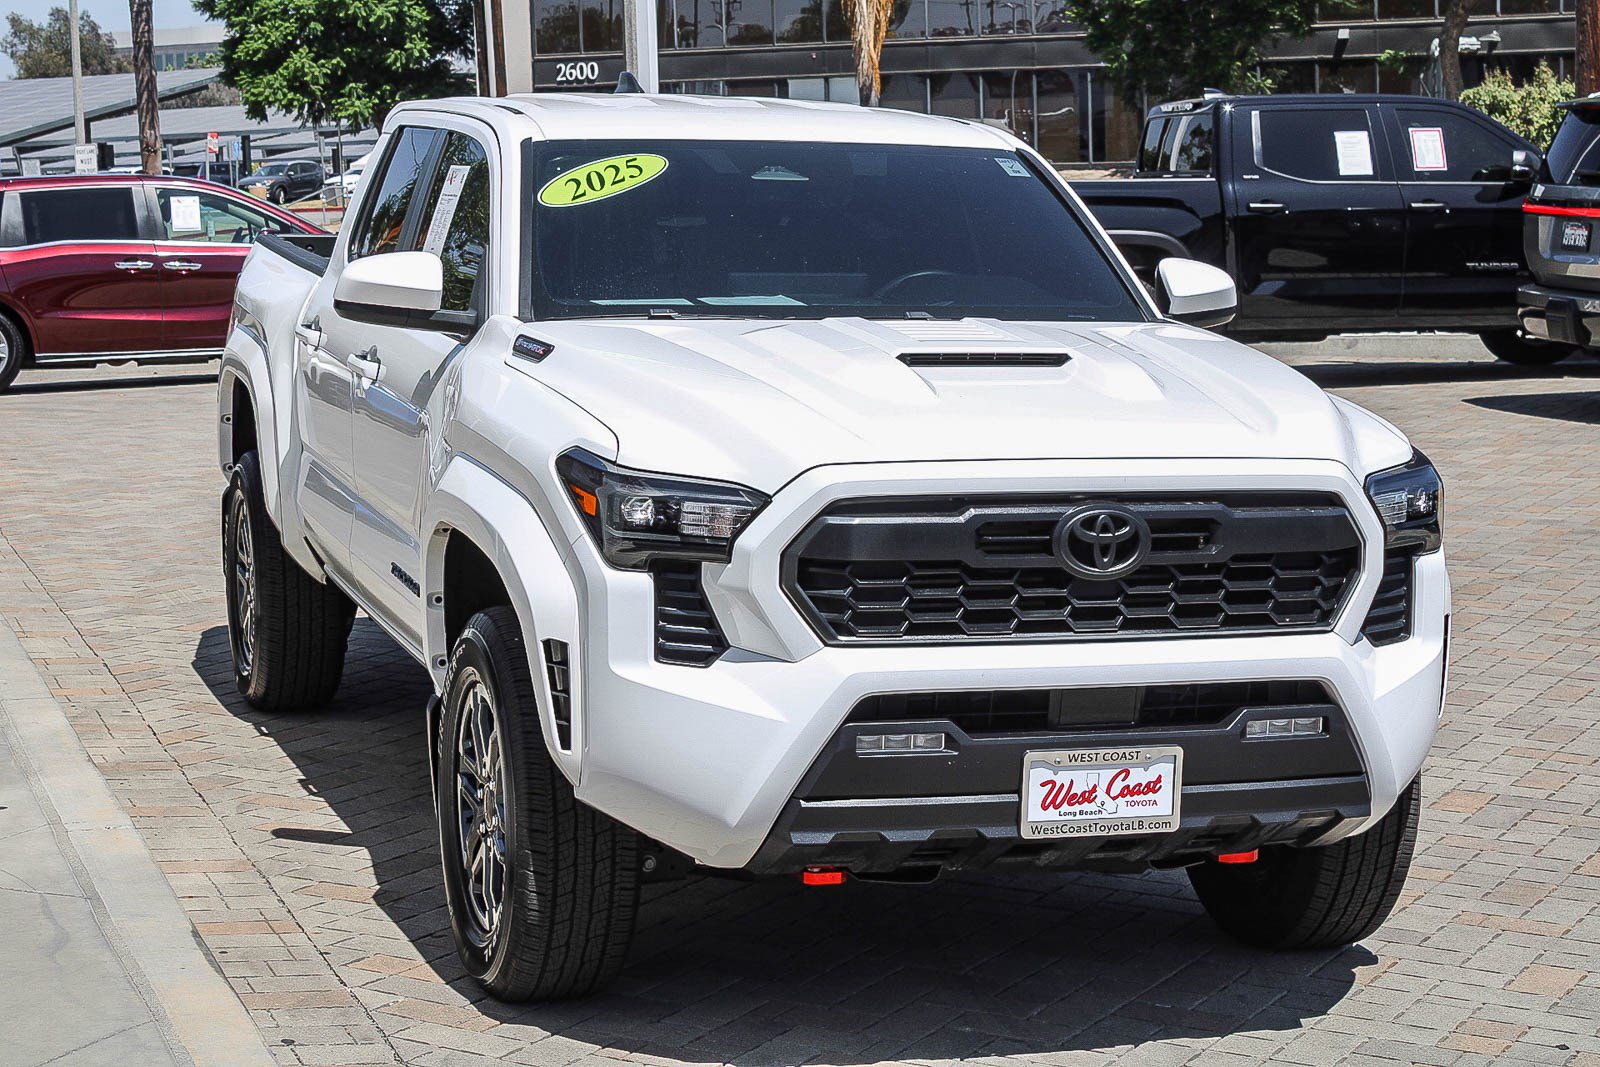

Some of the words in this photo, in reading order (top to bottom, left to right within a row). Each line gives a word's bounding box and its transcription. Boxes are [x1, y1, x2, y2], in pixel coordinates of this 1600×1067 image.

[556, 61, 599, 81] 2600
[564, 157, 643, 201] 2025
[1067, 752, 1100, 763] WEST
[1102, 750, 1141, 762] COAST
[1040, 778, 1097, 811] West
[1106, 768, 1163, 801] Coast
[1125, 799, 1158, 808] TOYOTA
[1030, 820, 1172, 835] WestCoastToyotaLB.com
